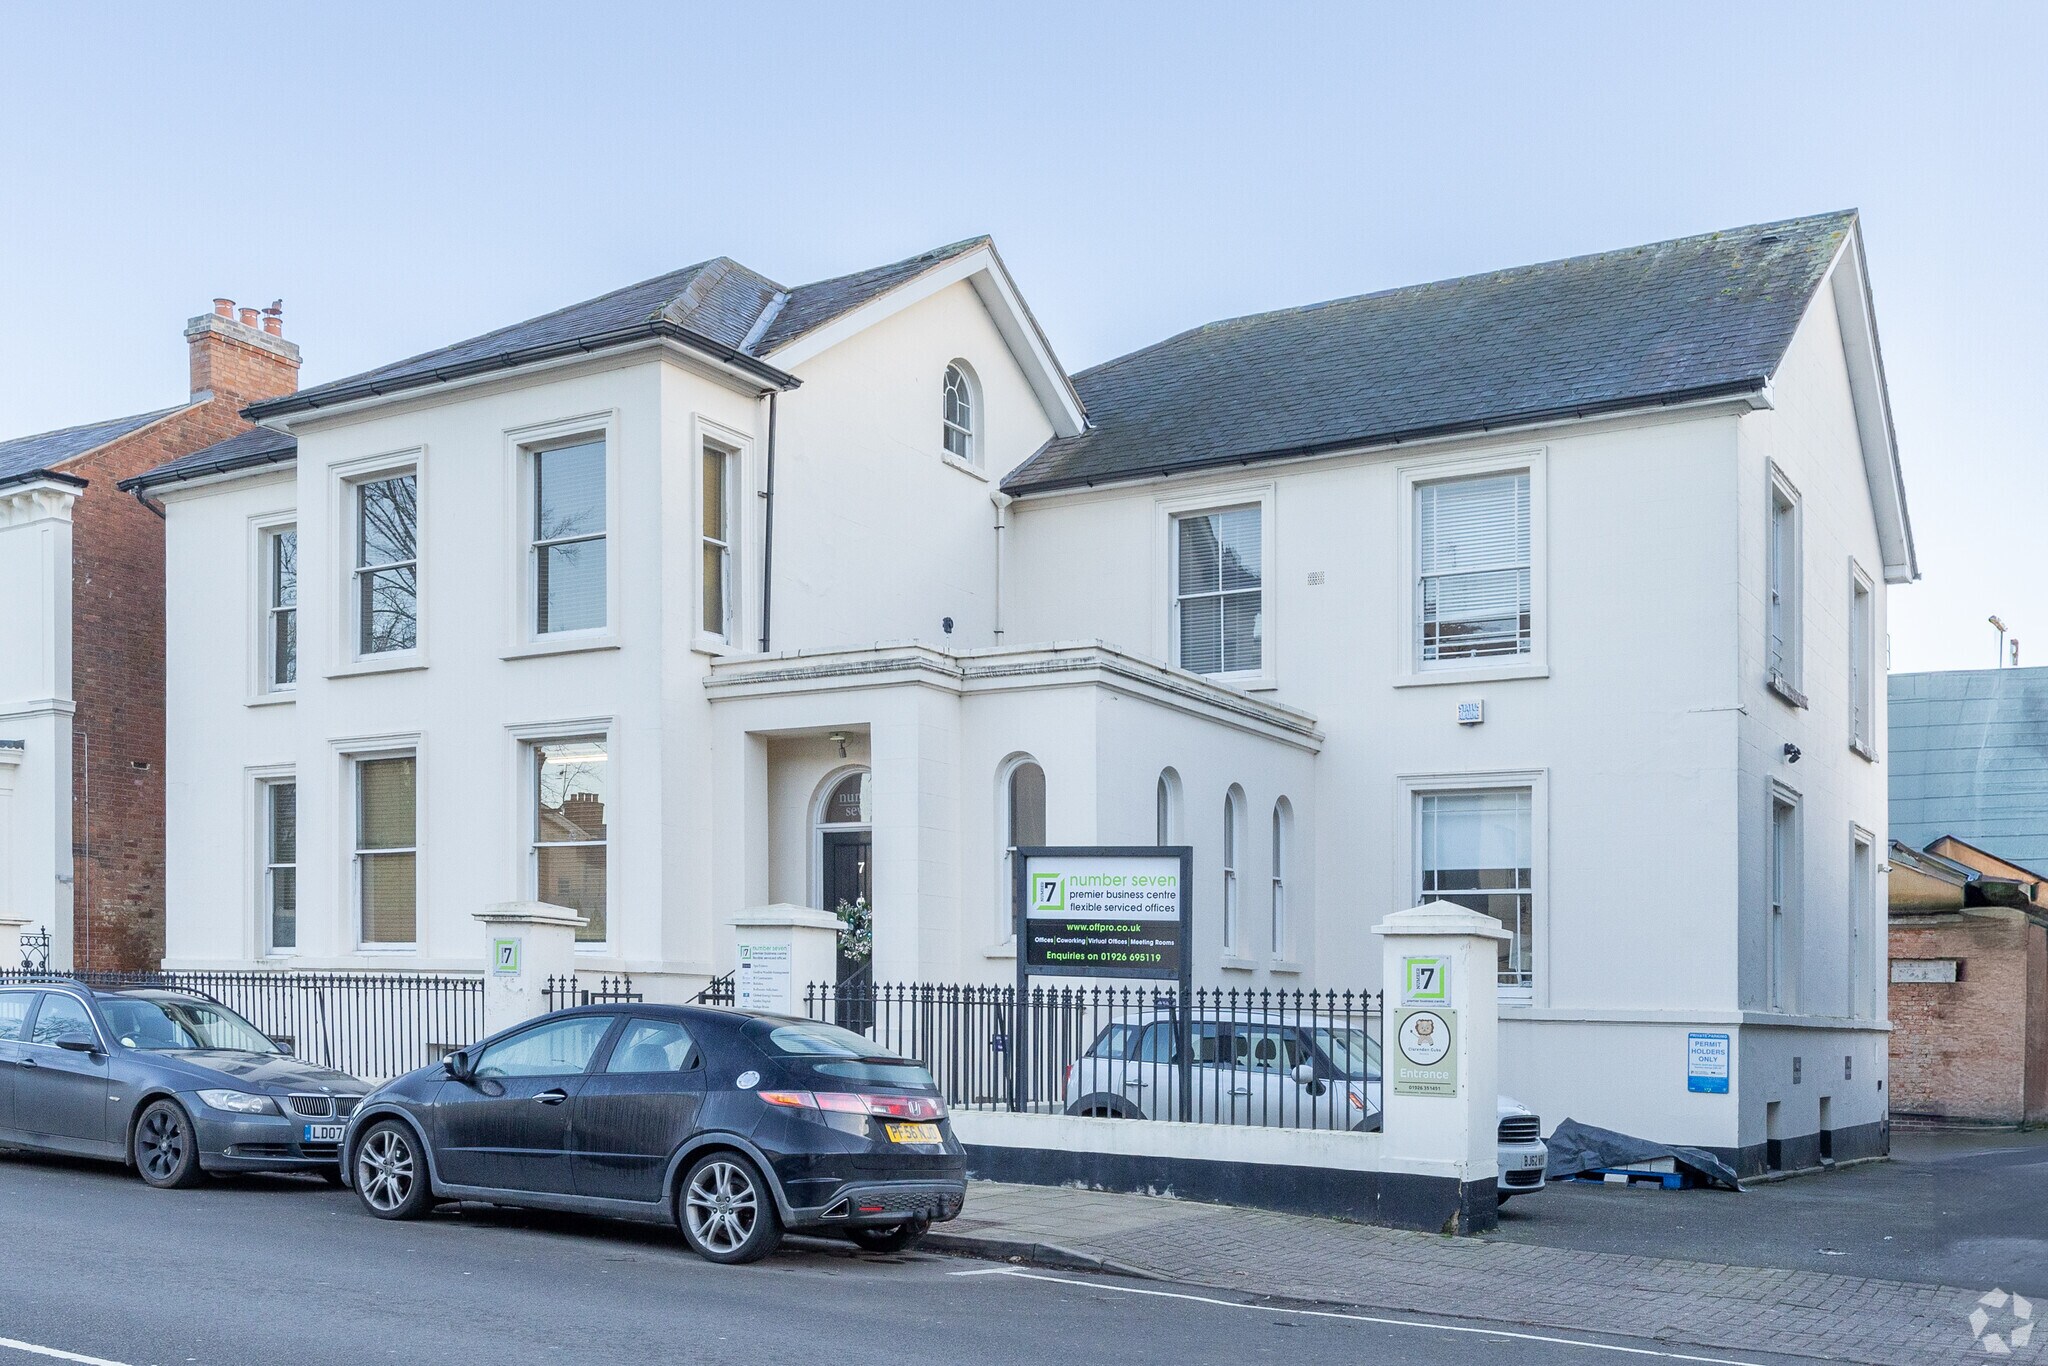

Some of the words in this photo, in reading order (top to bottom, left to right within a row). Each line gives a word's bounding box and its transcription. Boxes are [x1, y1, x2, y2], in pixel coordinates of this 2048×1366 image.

[858, 862, 865, 874] 7
[1070, 873, 1126, 886] number
[1132, 875, 1176, 886] seven
[1044, 882, 1056, 902] 7
[1070, 890, 1105, 900] premier
[1106, 890, 1144, 899] business
[1146, 890, 1176, 900] centre
[1070, 903, 1102, 912] flexible
[1104, 904, 1142, 912] serviced
[1146, 904, 1175, 912] offices
[1066, 923, 1141, 932] www.offpro.co.uk
[504, 948, 512, 964] 7
[1046, 951, 1085, 961] Enquiries
[1100, 952, 1127, 961] 01926
[1129, 953, 1161, 962] 695119
[1421, 968, 1434, 989] 7
[1400, 1068, 1449, 1079] Entrance
[312, 1127, 342, 1139] LD07
[891, 1126, 918, 1139] PF56
